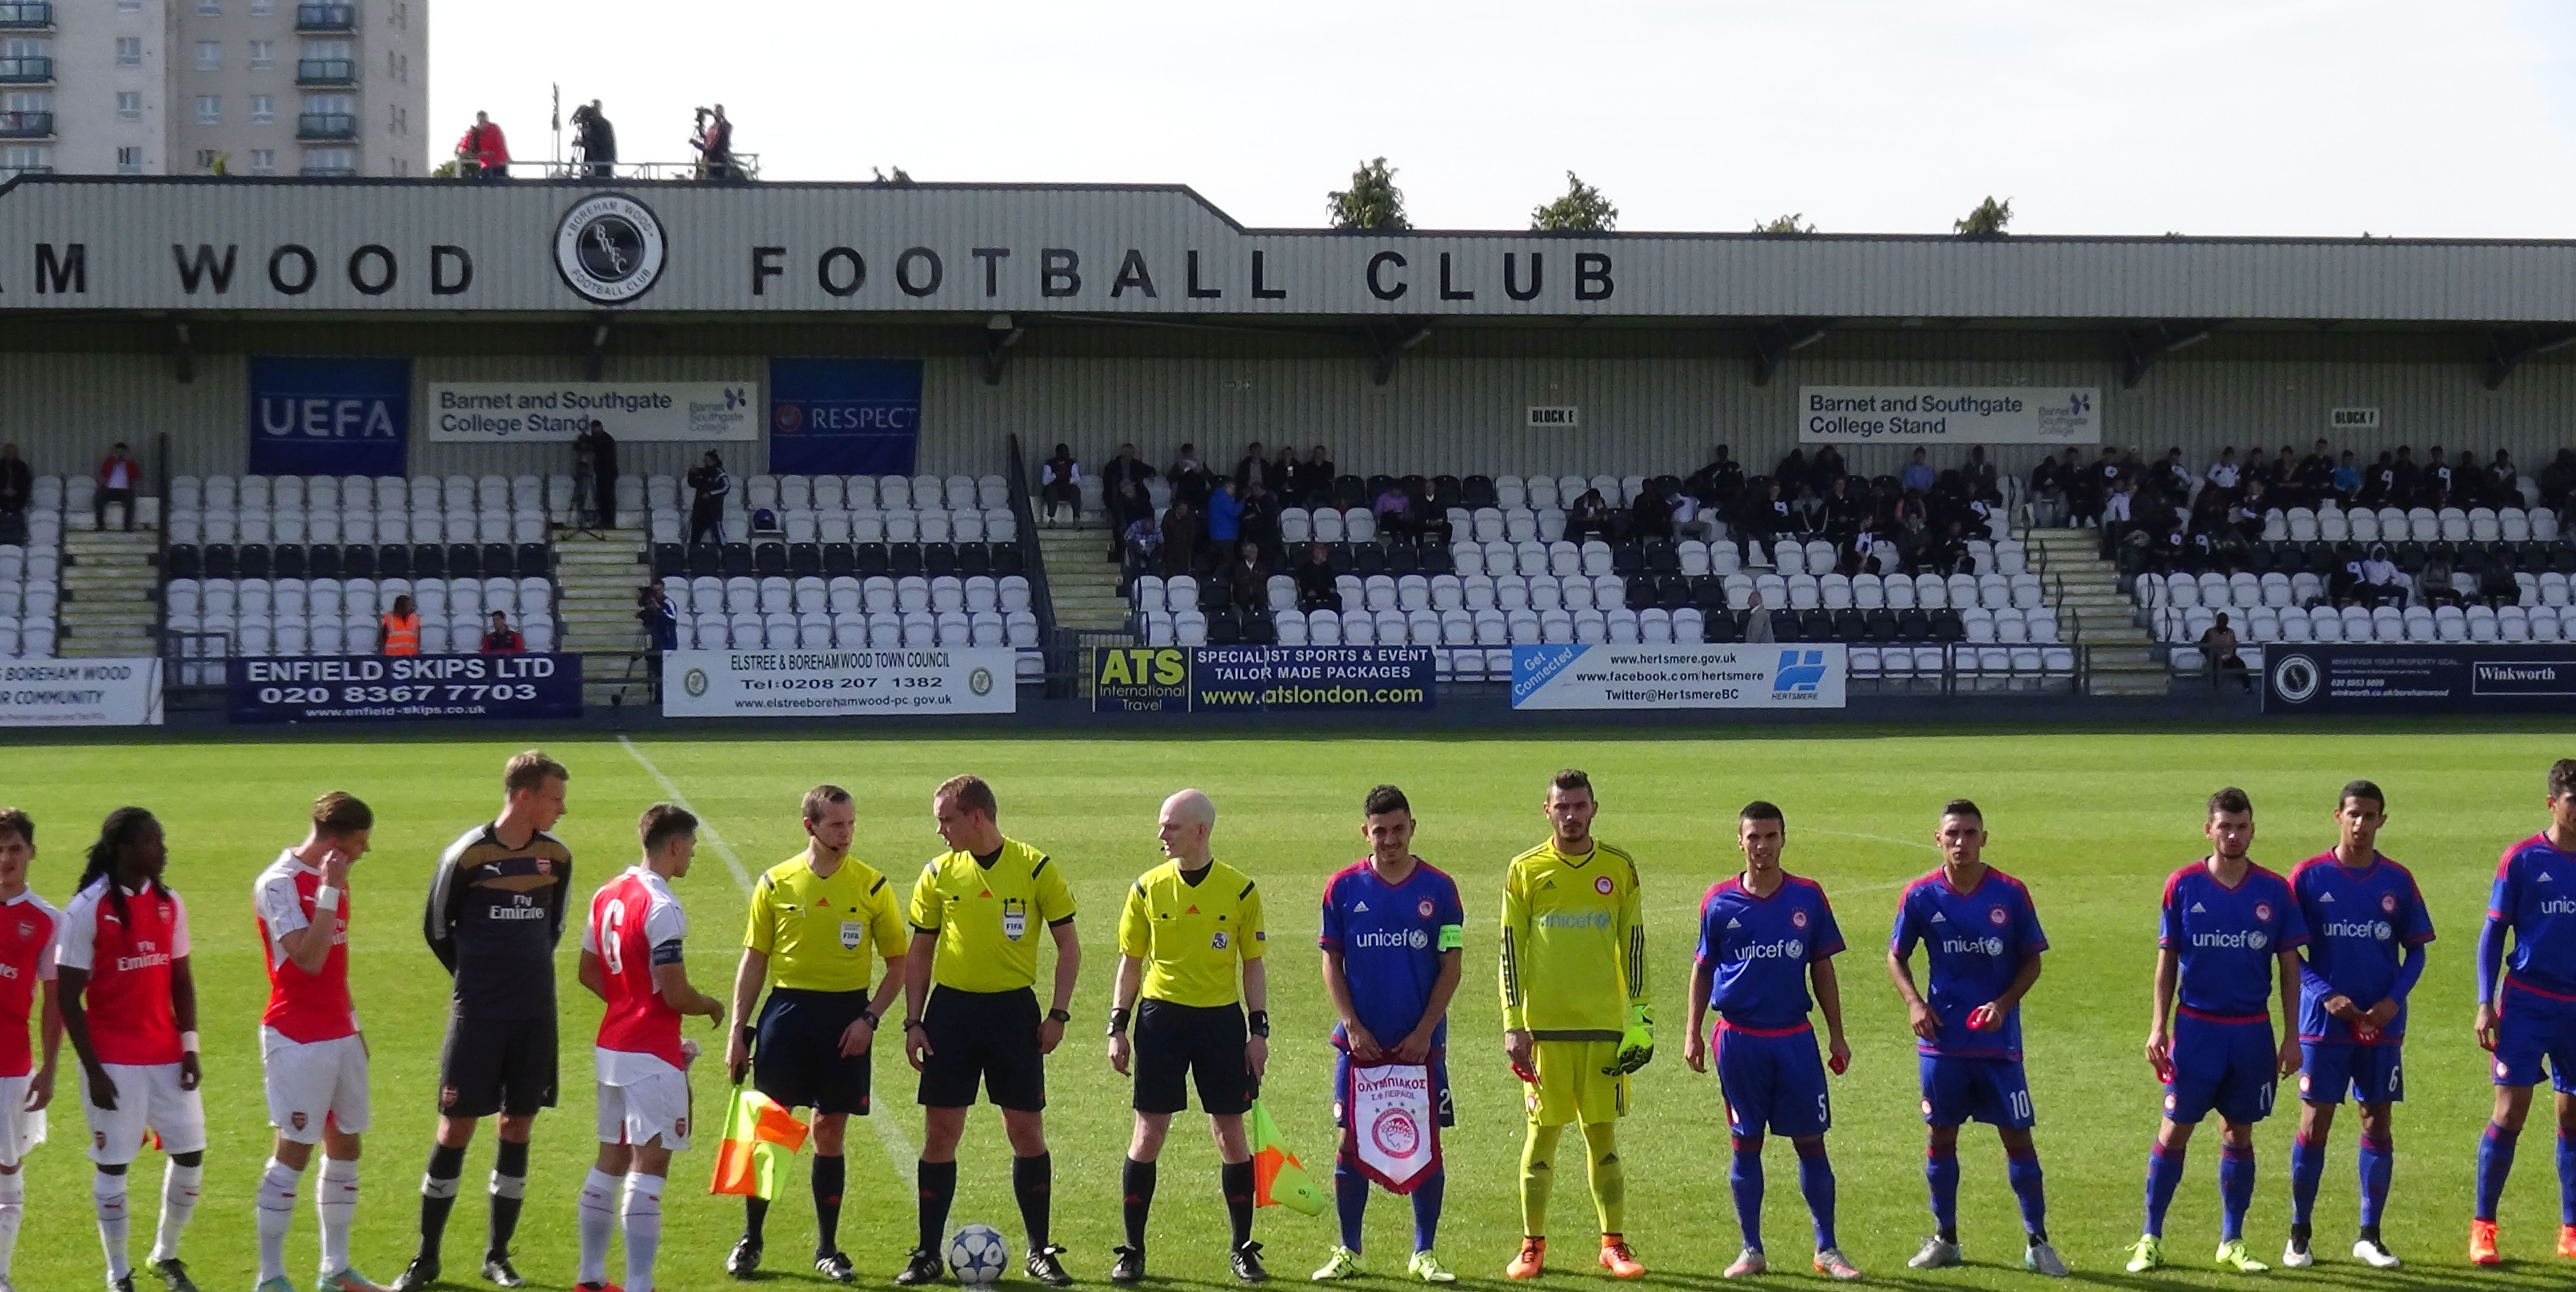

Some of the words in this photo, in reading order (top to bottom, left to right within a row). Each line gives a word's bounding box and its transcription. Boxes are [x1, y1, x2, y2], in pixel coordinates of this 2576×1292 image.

[0, 244, 86, 294] M
[172, 244, 473, 295] WOOD
[752, 246, 1287, 300] FOOTBALL
[1367, 251, 1615, 301] CLUB
[441, 391, 511, 409] Barnet
[518, 391, 557, 409] and
[563, 391, 672, 412] Southgate
[1810, 395, 1876, 412] Barnet
[1881, 395, 1916, 412] and
[1922, 395, 2022, 416] Southgate
[261, 398, 395, 437] UEFA
[441, 414, 522, 436] College
[527, 414, 591, 432] Stand
[812, 407, 918, 429] RESPECT
[1532, 410, 1565, 423] BLOCK
[1568, 410, 1574, 423] E
[1810, 416, 1884, 437] College
[1889, 417, 1946, 434] Stand
[2335, 411, 2367, 424] BLOCK
[731, 654, 776, 670] ELSTREE
[779, 654, 786, 670] &
[875, 652, 904, 668] TOWN
[907, 652, 950, 668] COUNCIL
[1197, 650, 1288, 664] SPECIALIST
[1295, 650, 1357, 663] SPORTS
[1362, 650, 1372, 662] &
[1378, 649, 1428, 662] EVENT
[1524, 650, 1547, 672] Get
[1611, 653, 1738, 666] www.hertsmere.gov.uk
[5, 666, 80, 681] BOREHAM
[84, 665, 131, 680] WOOD
[248, 660, 384, 682] ENFIELD
[392, 659, 486, 680] SKIPS
[495, 658, 556, 679] LTD
[1100, 649, 1186, 685] ATS
[1215, 667, 1271, 680] TAILOR
[1277, 667, 1320, 680] MADE
[1327, 666, 1411, 679] PACKAGES
[1515, 648, 1574, 697] Connected
[2479, 667, 2556, 680] Winkworth
[840, 678, 878, 688] 207
[892, 677, 942, 688] 1382
[1100, 685, 1185, 697] International
[15, 690, 105, 704] COMMUNITY
[259, 686, 330, 703] 020
[344, 685, 436, 703] 8367
[443, 684, 538, 701] 7703
[1201, 686, 1424, 705] www.atslondon.com
[1605, 689, 1739, 702] Twitter@HertsmereBC
[1122, 699, 1163, 711] Travel
[2541, 895, 2576, 914] unic
[602, 898, 625, 975] 6
[1356, 928, 1409, 948] unicef
[2323, 918, 2374, 938] unicef
[2192, 929, 2247, 948] unicef
[1734, 939, 1784, 961] unicef
[1358, 1077, 1426, 1092] ΟΛΥΜΠΙΑΚΟΣ
[2388, 1065, 2400, 1092] 6
[1439, 1088, 1451, 1115] 2
[1615, 1083, 1619, 1111] 1
[2009, 1089, 2030, 1120] 10
[1818, 1093, 1827, 1123] 5
